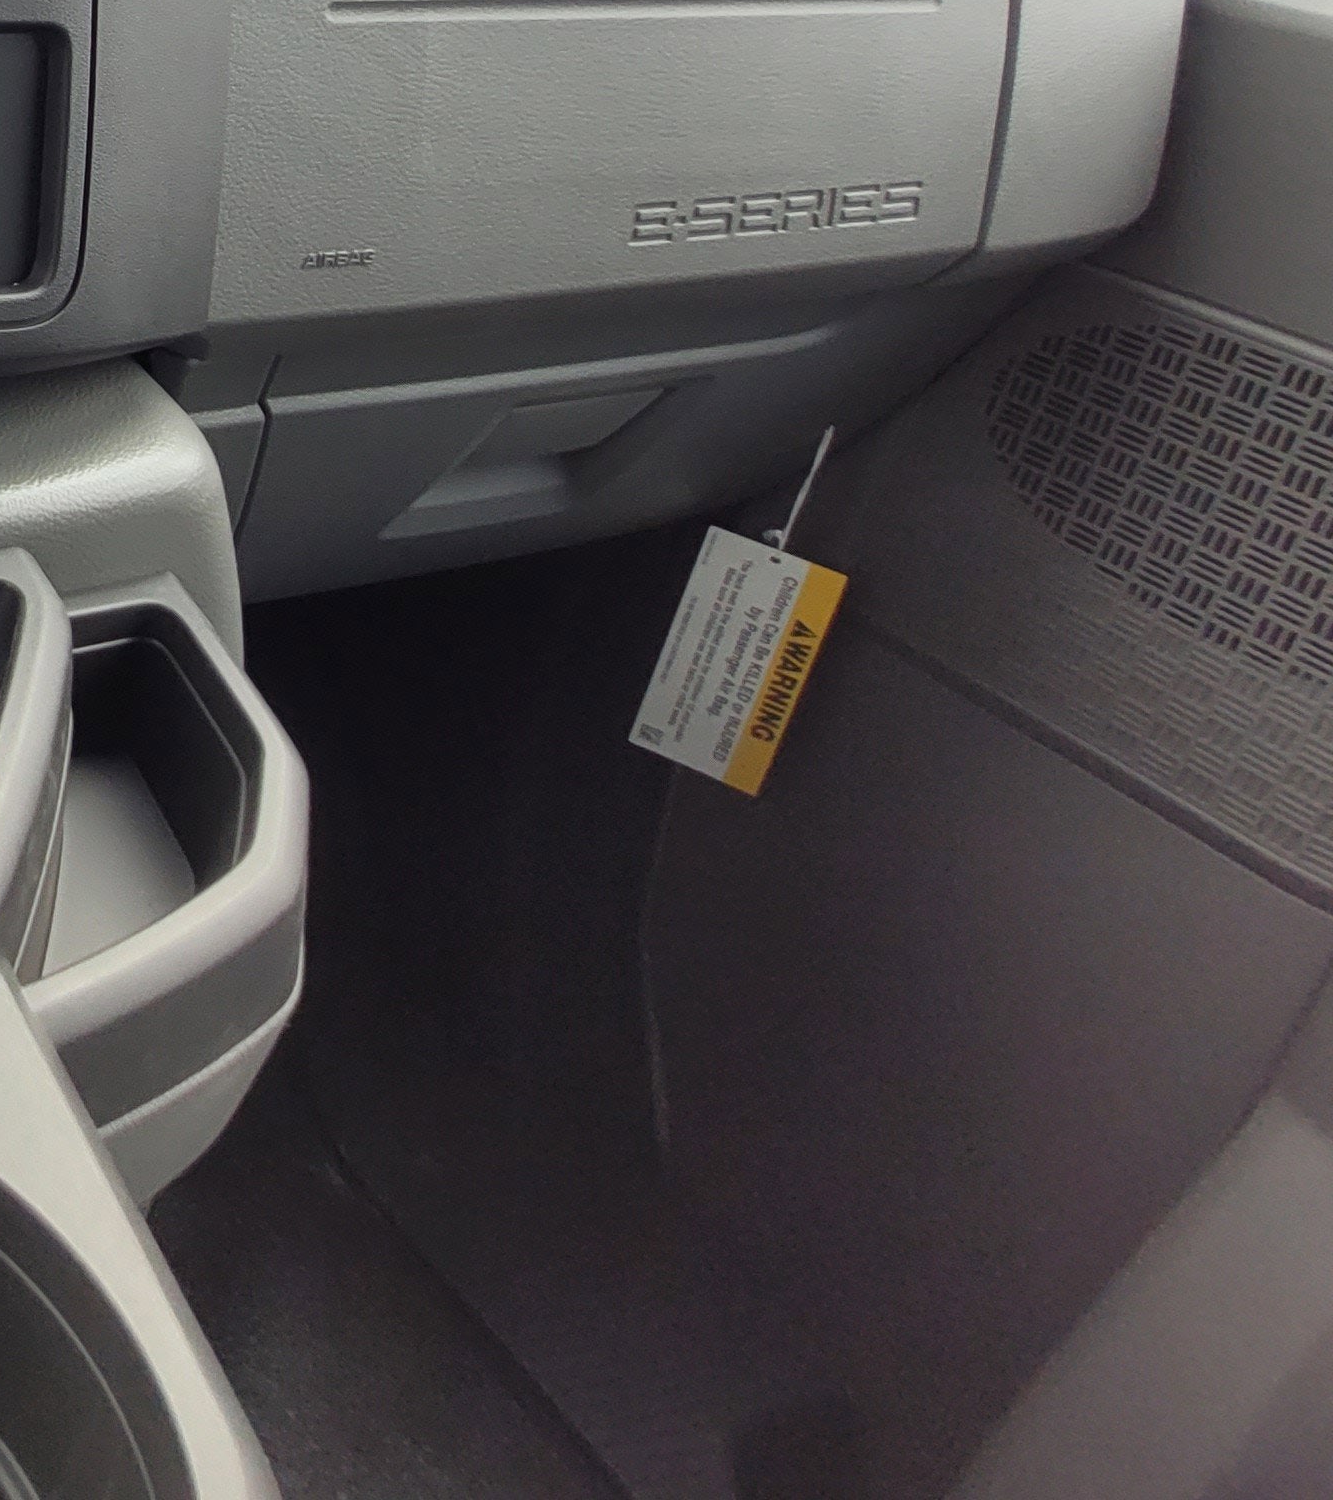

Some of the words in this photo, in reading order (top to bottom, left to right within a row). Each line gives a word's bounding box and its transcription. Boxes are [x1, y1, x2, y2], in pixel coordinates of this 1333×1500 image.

[627, 179, 925, 247] E-SERIES
[744, 606, 762, 619] by
[768, 577, 797, 621] Children
[722, 622, 755, 676] Passenger
[758, 623, 778, 644] Can
[719, 679, 733, 693] Air
[735, 662, 762, 702] KILLED
[748, 639, 810, 743] WARNING
